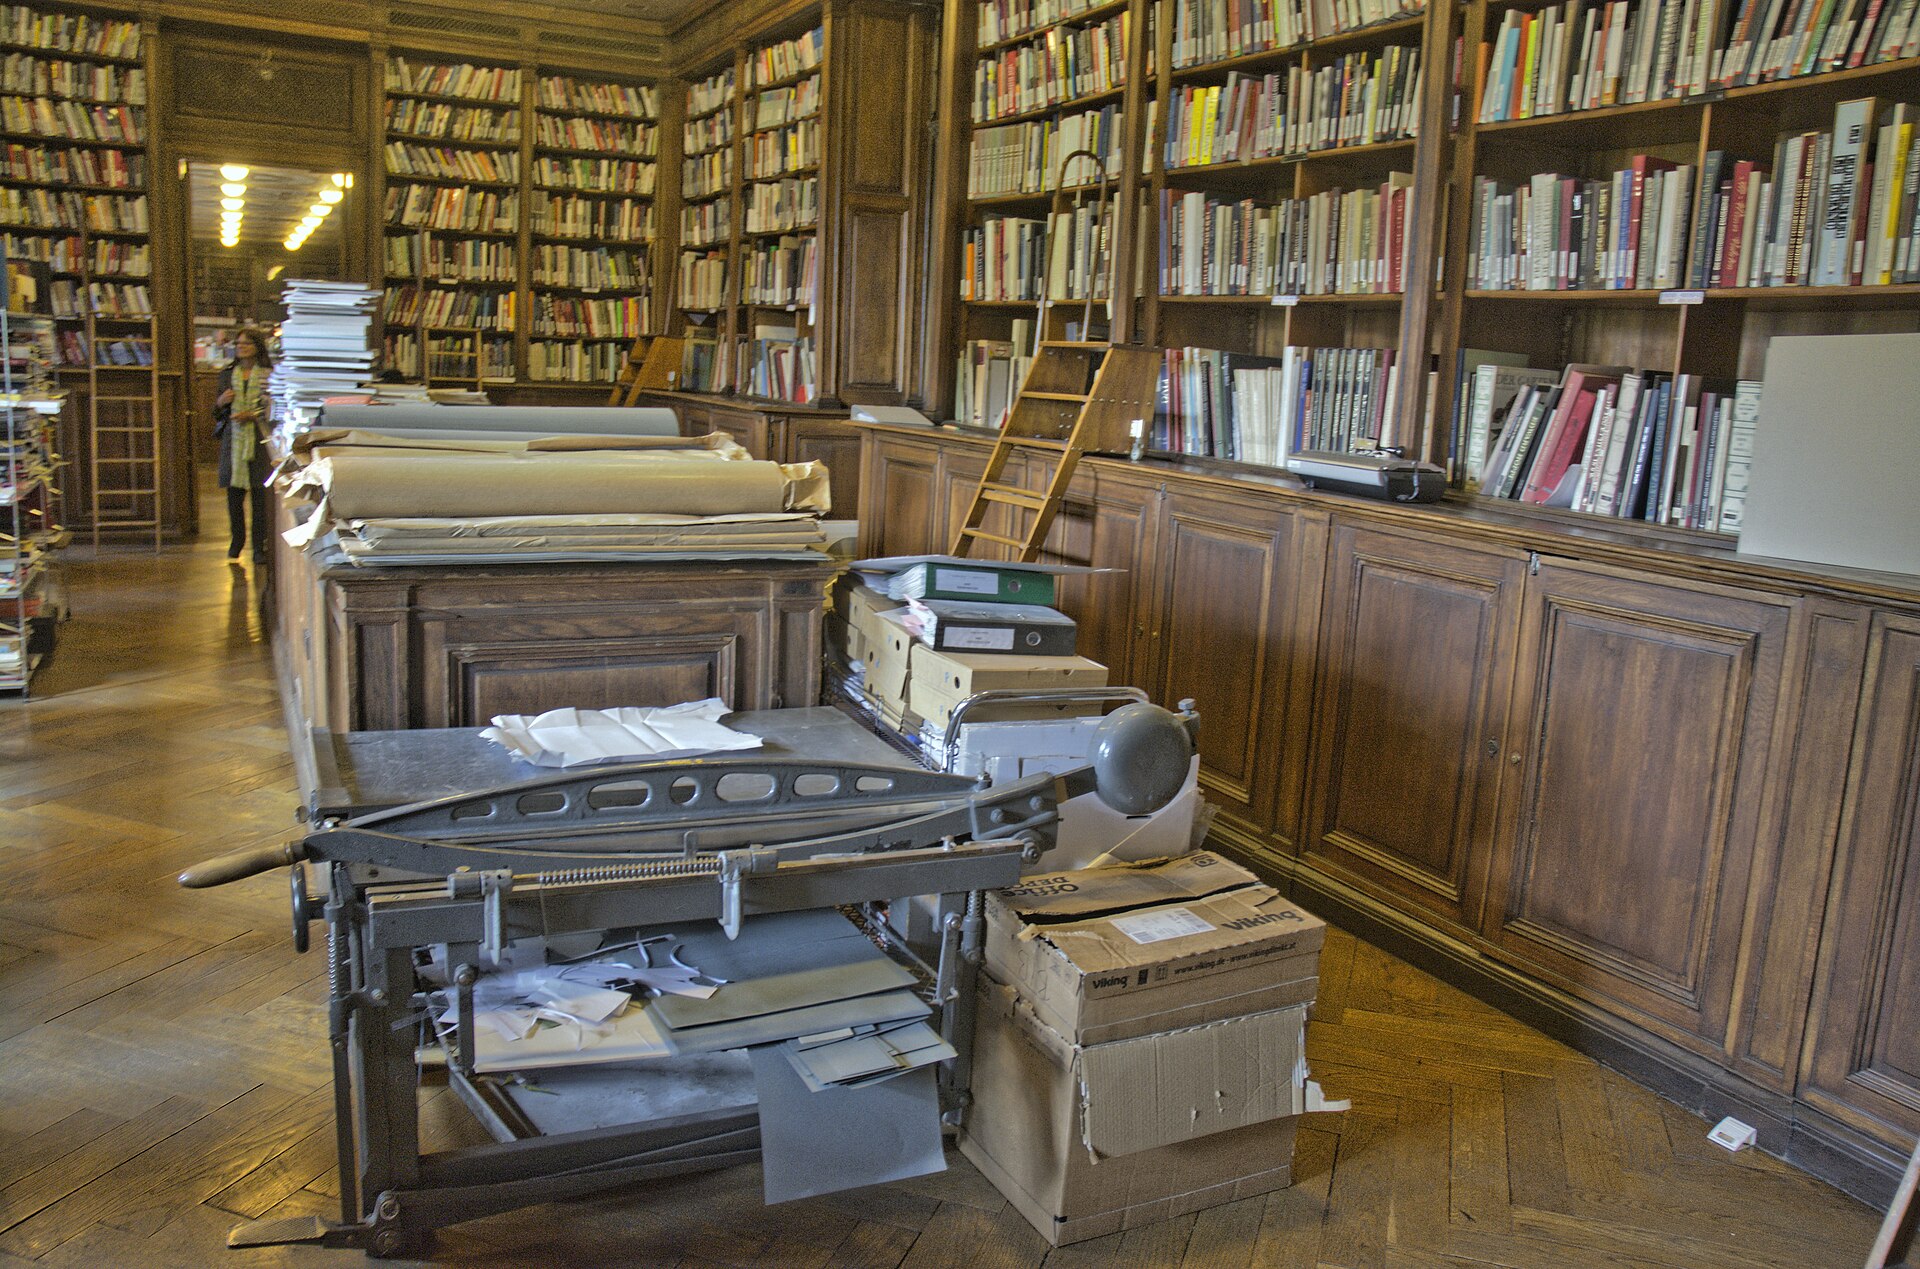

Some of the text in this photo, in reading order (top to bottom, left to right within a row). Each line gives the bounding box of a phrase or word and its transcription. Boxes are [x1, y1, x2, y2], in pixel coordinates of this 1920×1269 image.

[1520, 416, 1538, 452] EDWARD
[1000, 883, 1079, 897] Office
[1221, 910, 1306, 932] Viking
[1093, 975, 1130, 990] Viking
